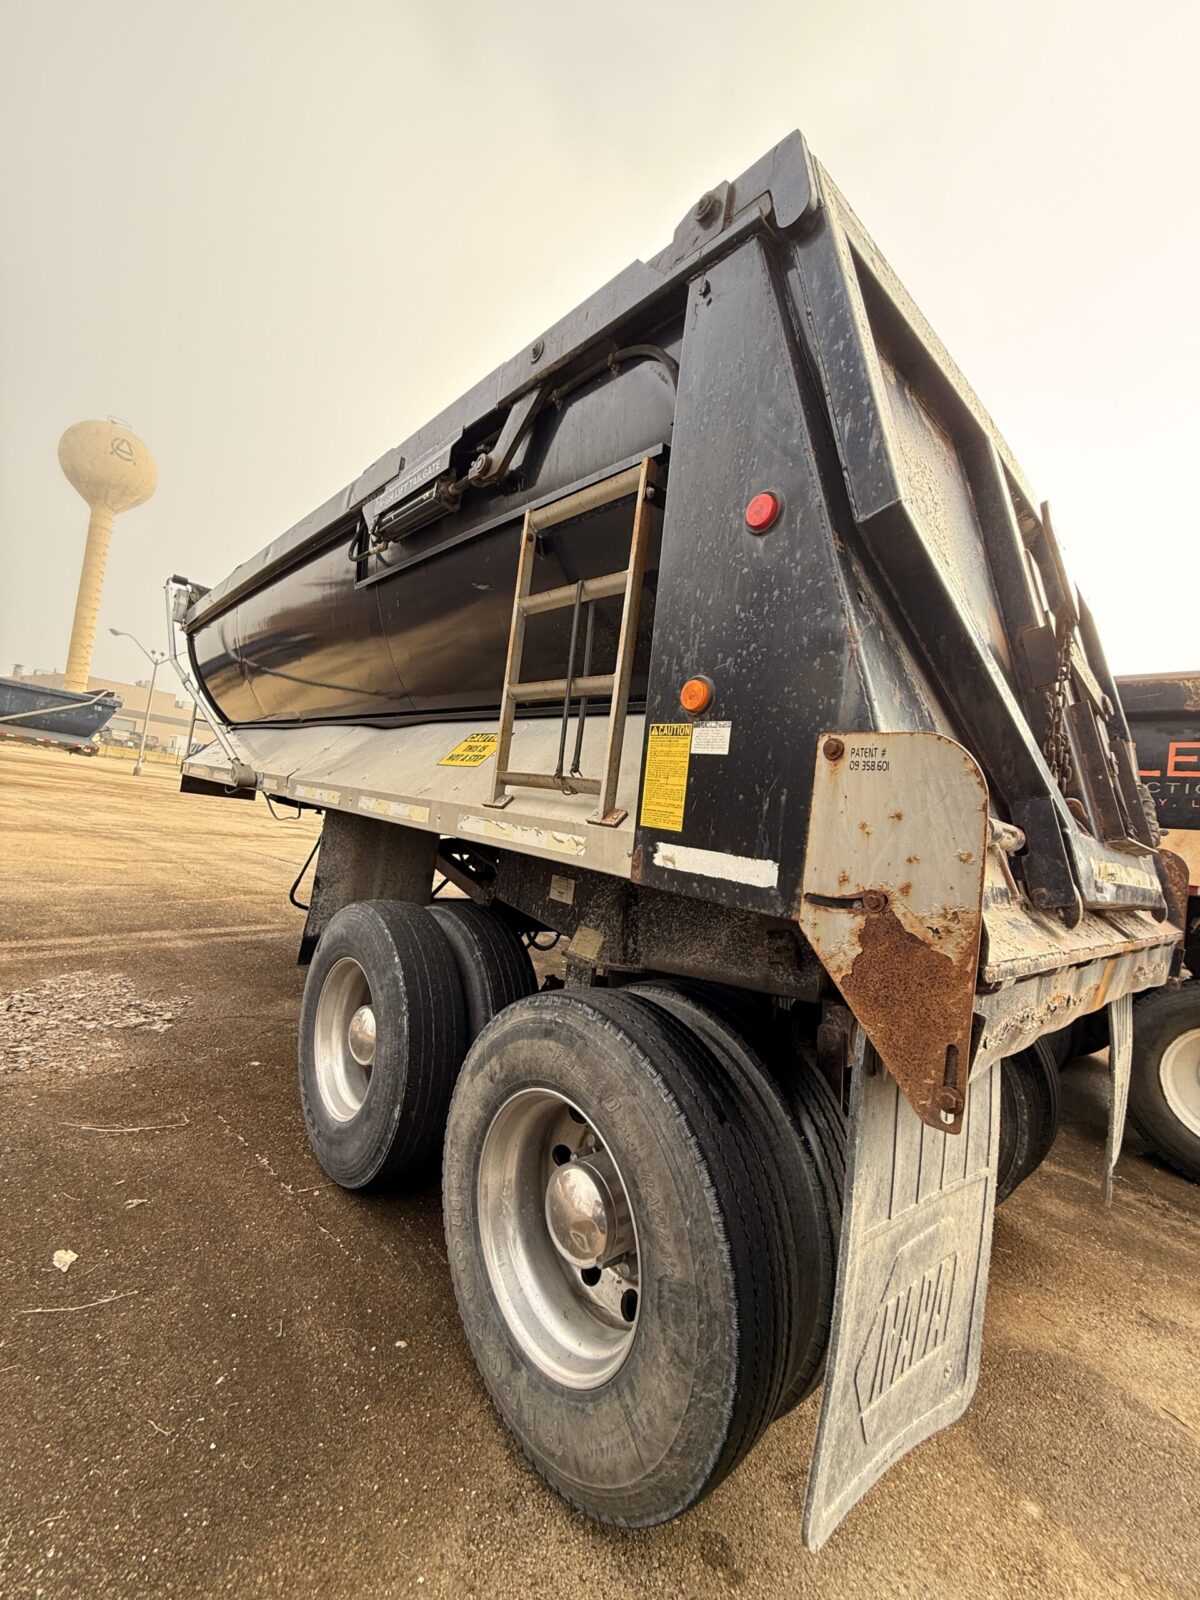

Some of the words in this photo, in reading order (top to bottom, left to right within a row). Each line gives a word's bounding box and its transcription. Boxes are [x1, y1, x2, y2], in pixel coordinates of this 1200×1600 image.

[658, 725, 690, 736] CAUTION
[850, 747, 878, 758] PATENT
[881, 747, 887, 757] #
[849, 760, 860, 770] 09
